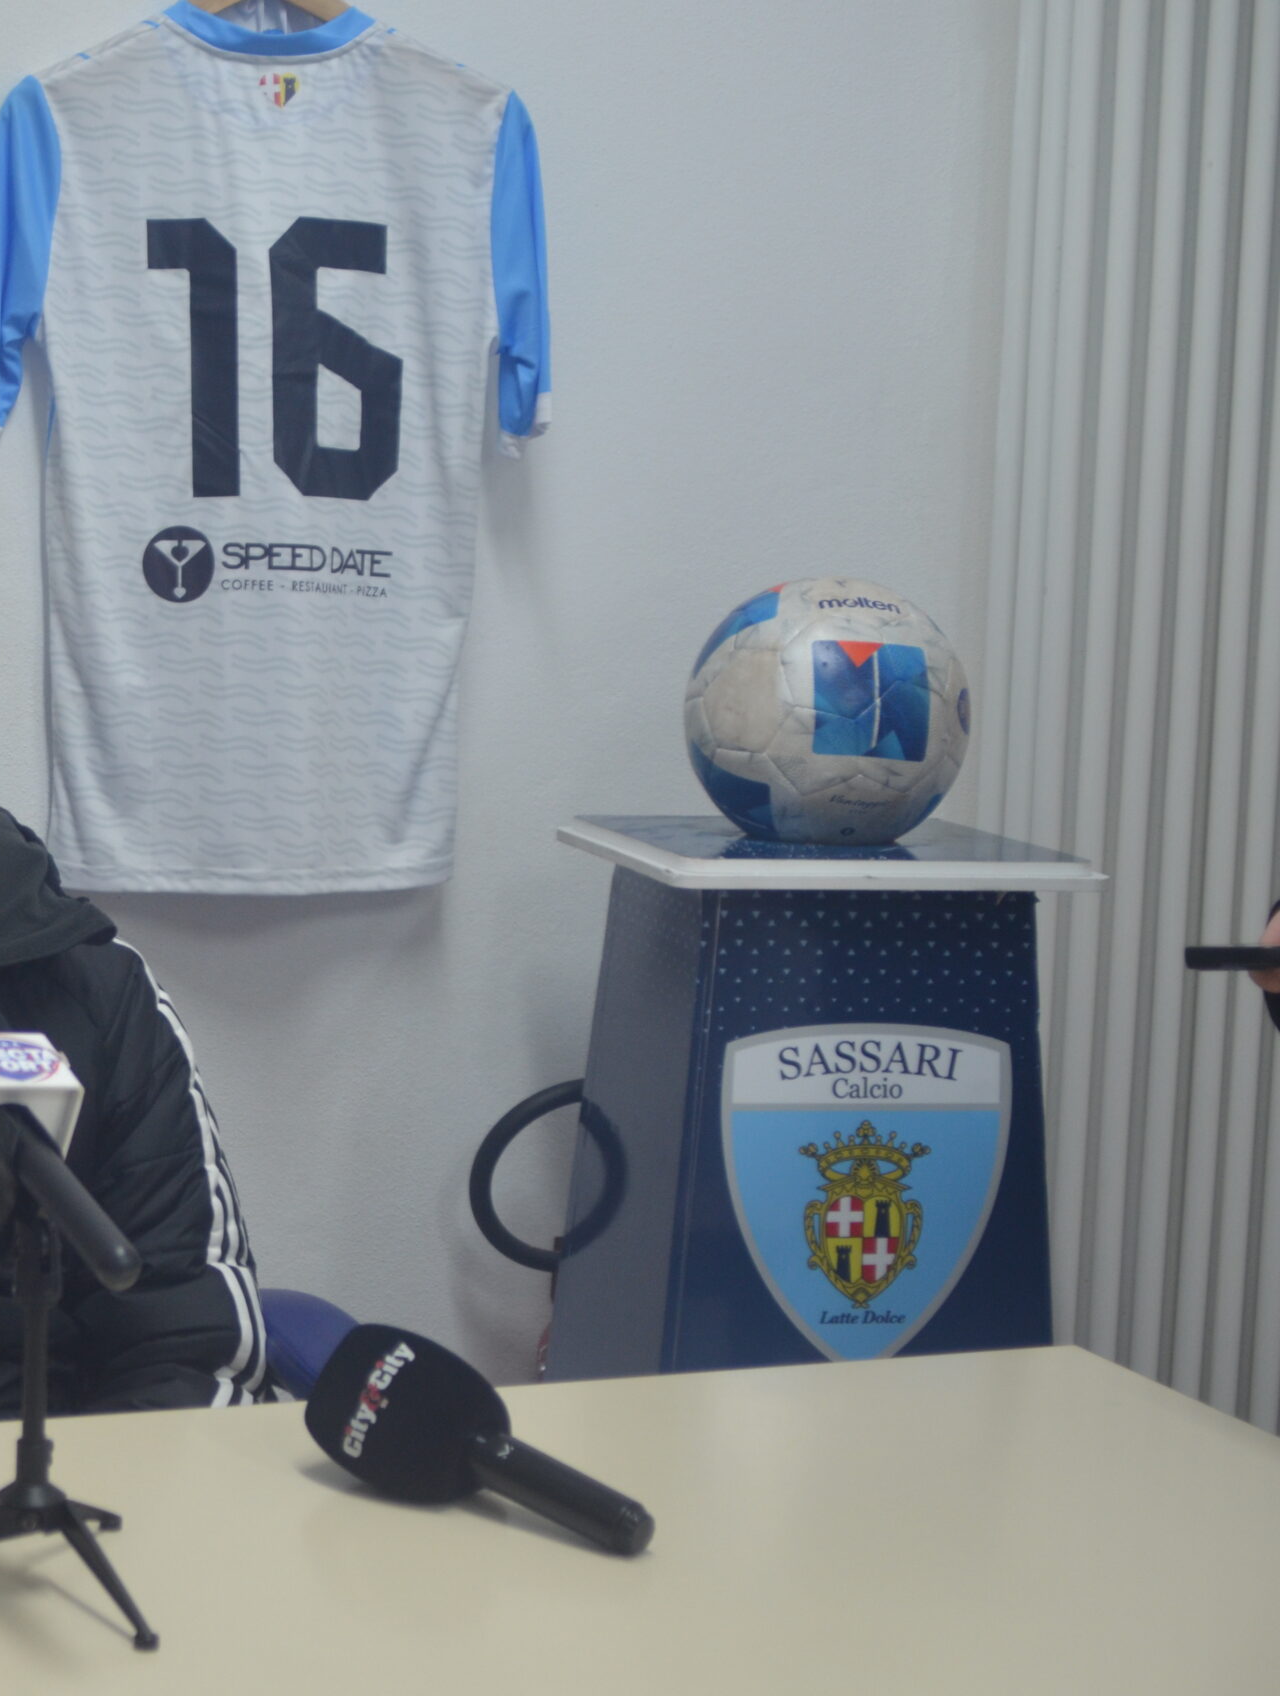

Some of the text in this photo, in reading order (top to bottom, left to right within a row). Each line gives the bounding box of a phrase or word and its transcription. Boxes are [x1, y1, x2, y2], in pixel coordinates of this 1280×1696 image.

[146, 215, 404, 501] 16
[221, 542, 393, 578] SPEED DATE
[221, 579, 274, 592] COFFEE
[356, 585, 388, 599] PIZZA
[818, 597, 901, 614] molten
[778, 1040, 963, 1082] SASSARI
[831, 1076, 904, 1100] Calcio
[819, 1310, 906, 1325] Latte Dolce
